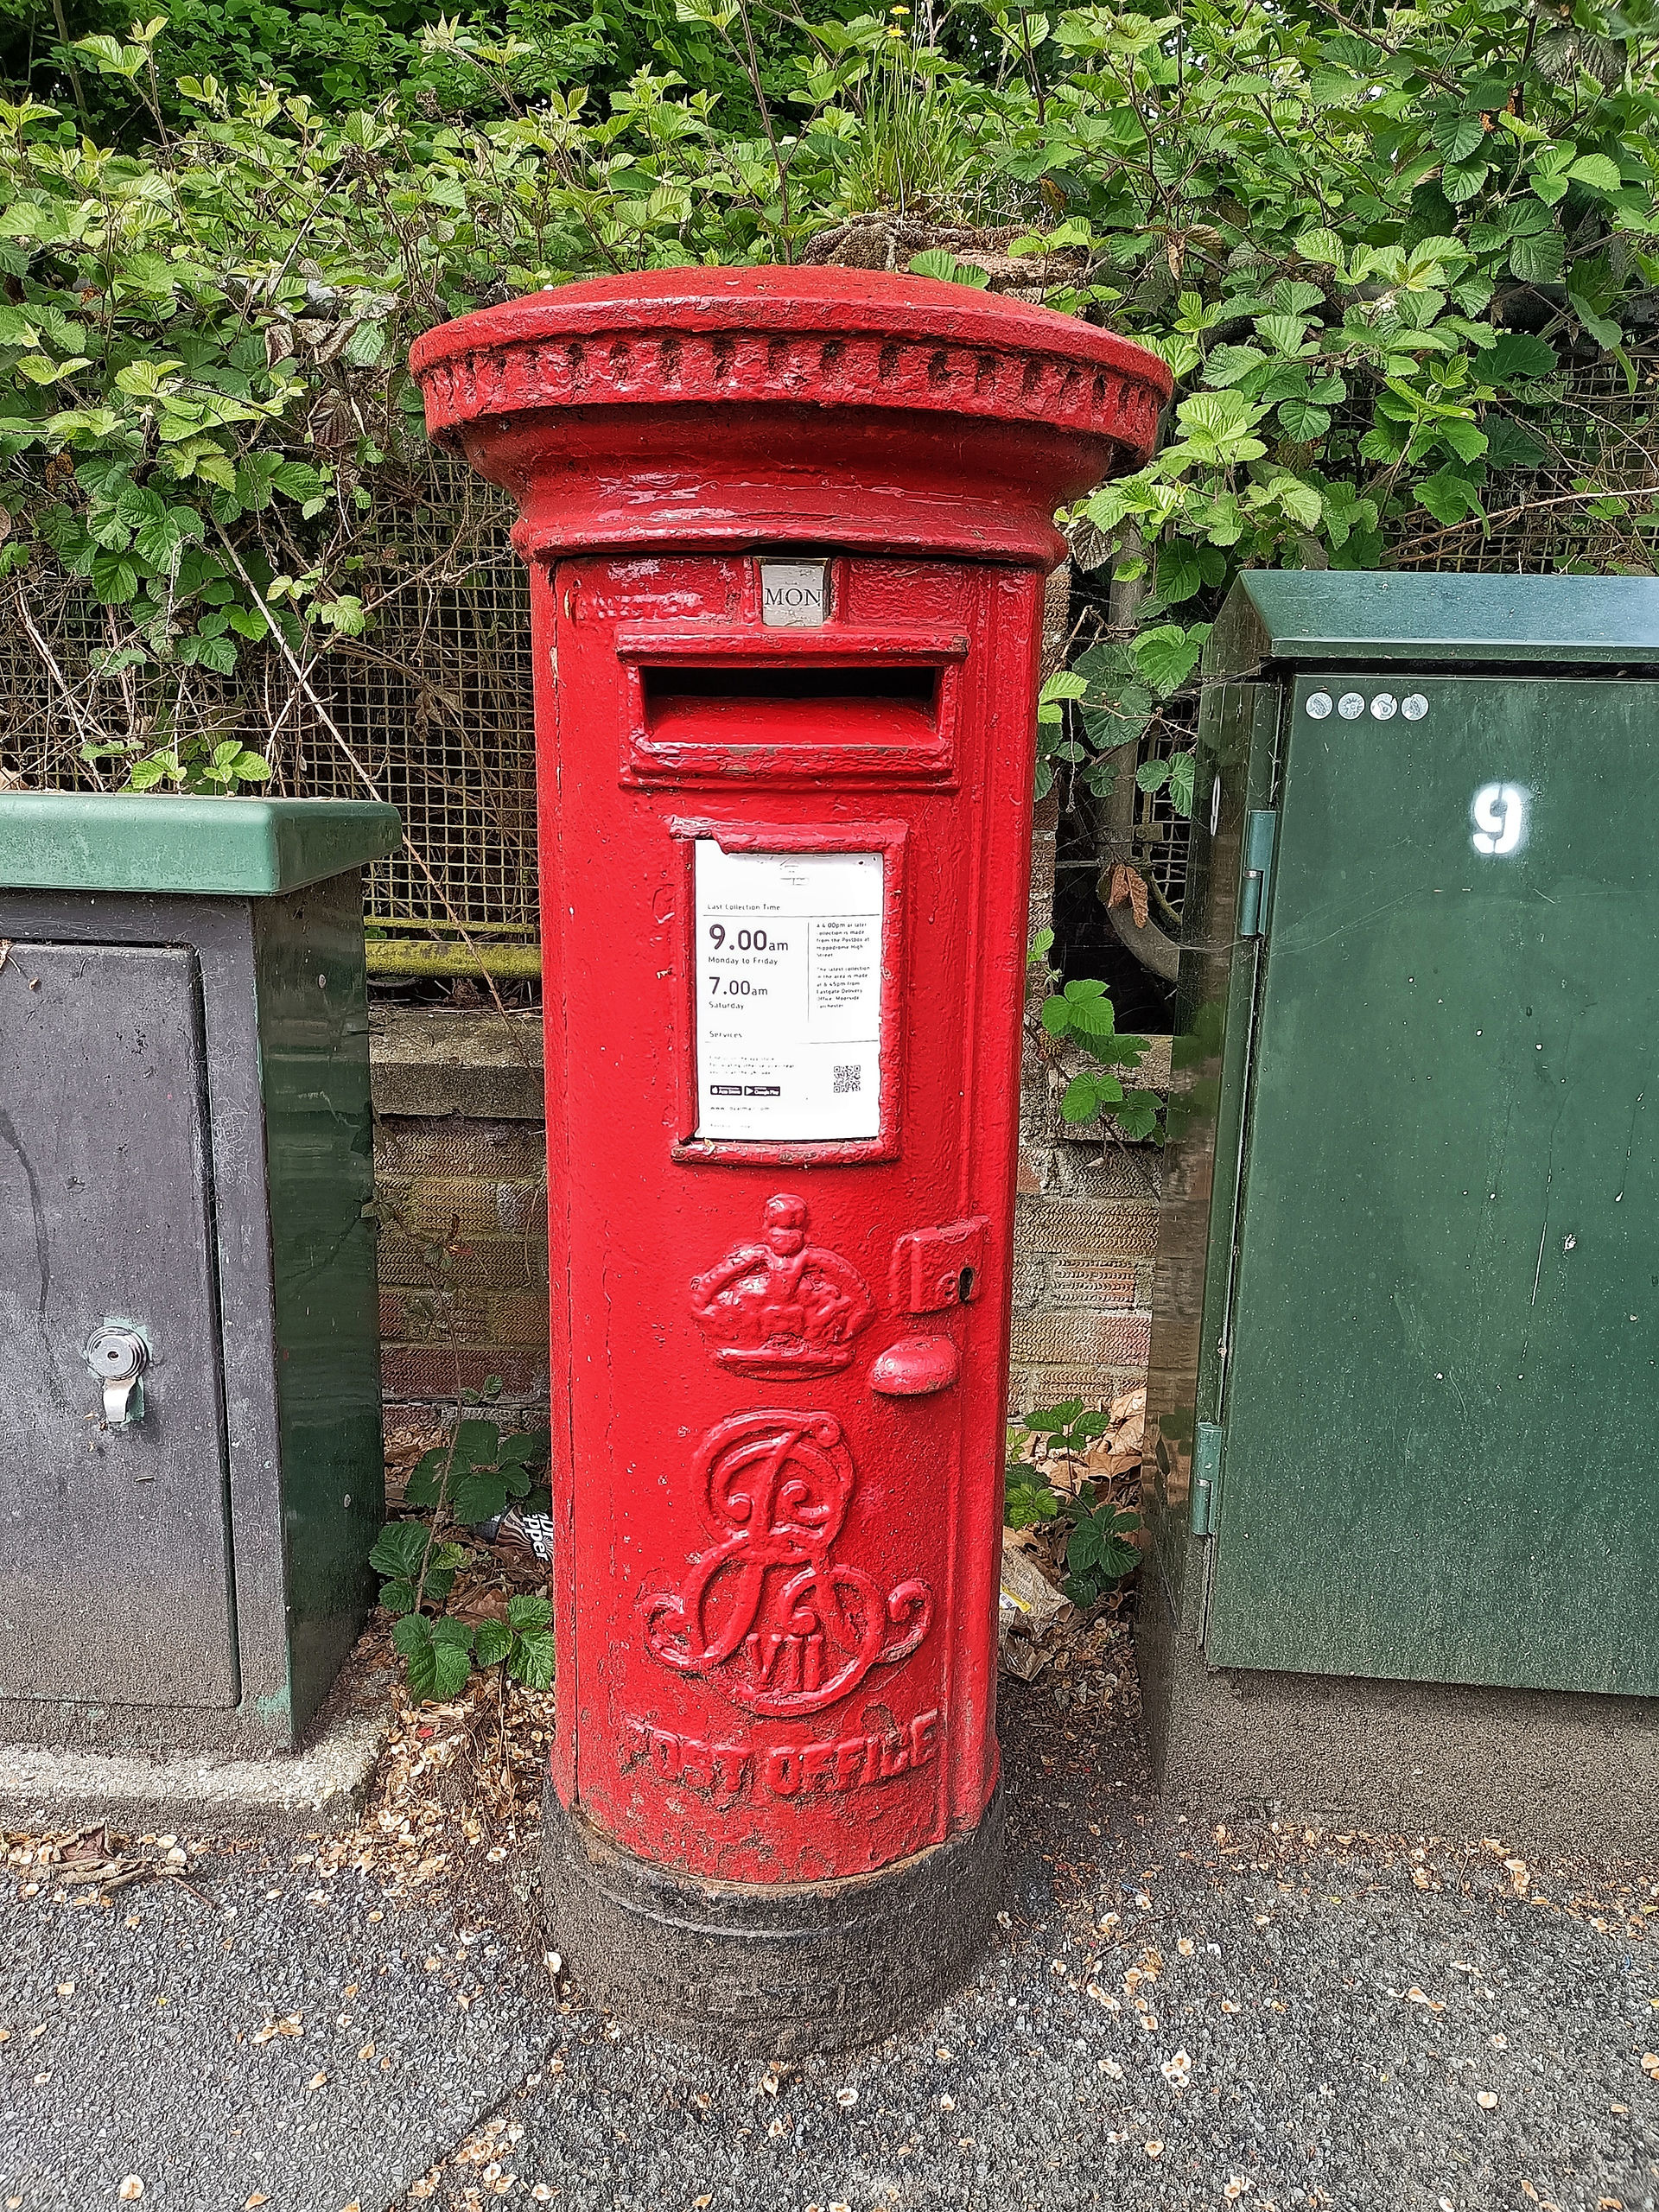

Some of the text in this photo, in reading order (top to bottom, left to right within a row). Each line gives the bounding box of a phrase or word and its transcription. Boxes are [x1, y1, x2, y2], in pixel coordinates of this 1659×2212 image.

[765, 588, 823, 607] MON
[1472, 784, 1522, 855] 9
[709, 923, 790, 951] 9.00am
[709, 957, 740, 965] Monday
[753, 957, 779, 965] Friday
[709, 976, 769, 996] 7.00am
[709, 1001, 744, 1010] Saturday
[709, 1030, 742, 1039] Services
[766, 1707, 939, 1796] OFFICE
